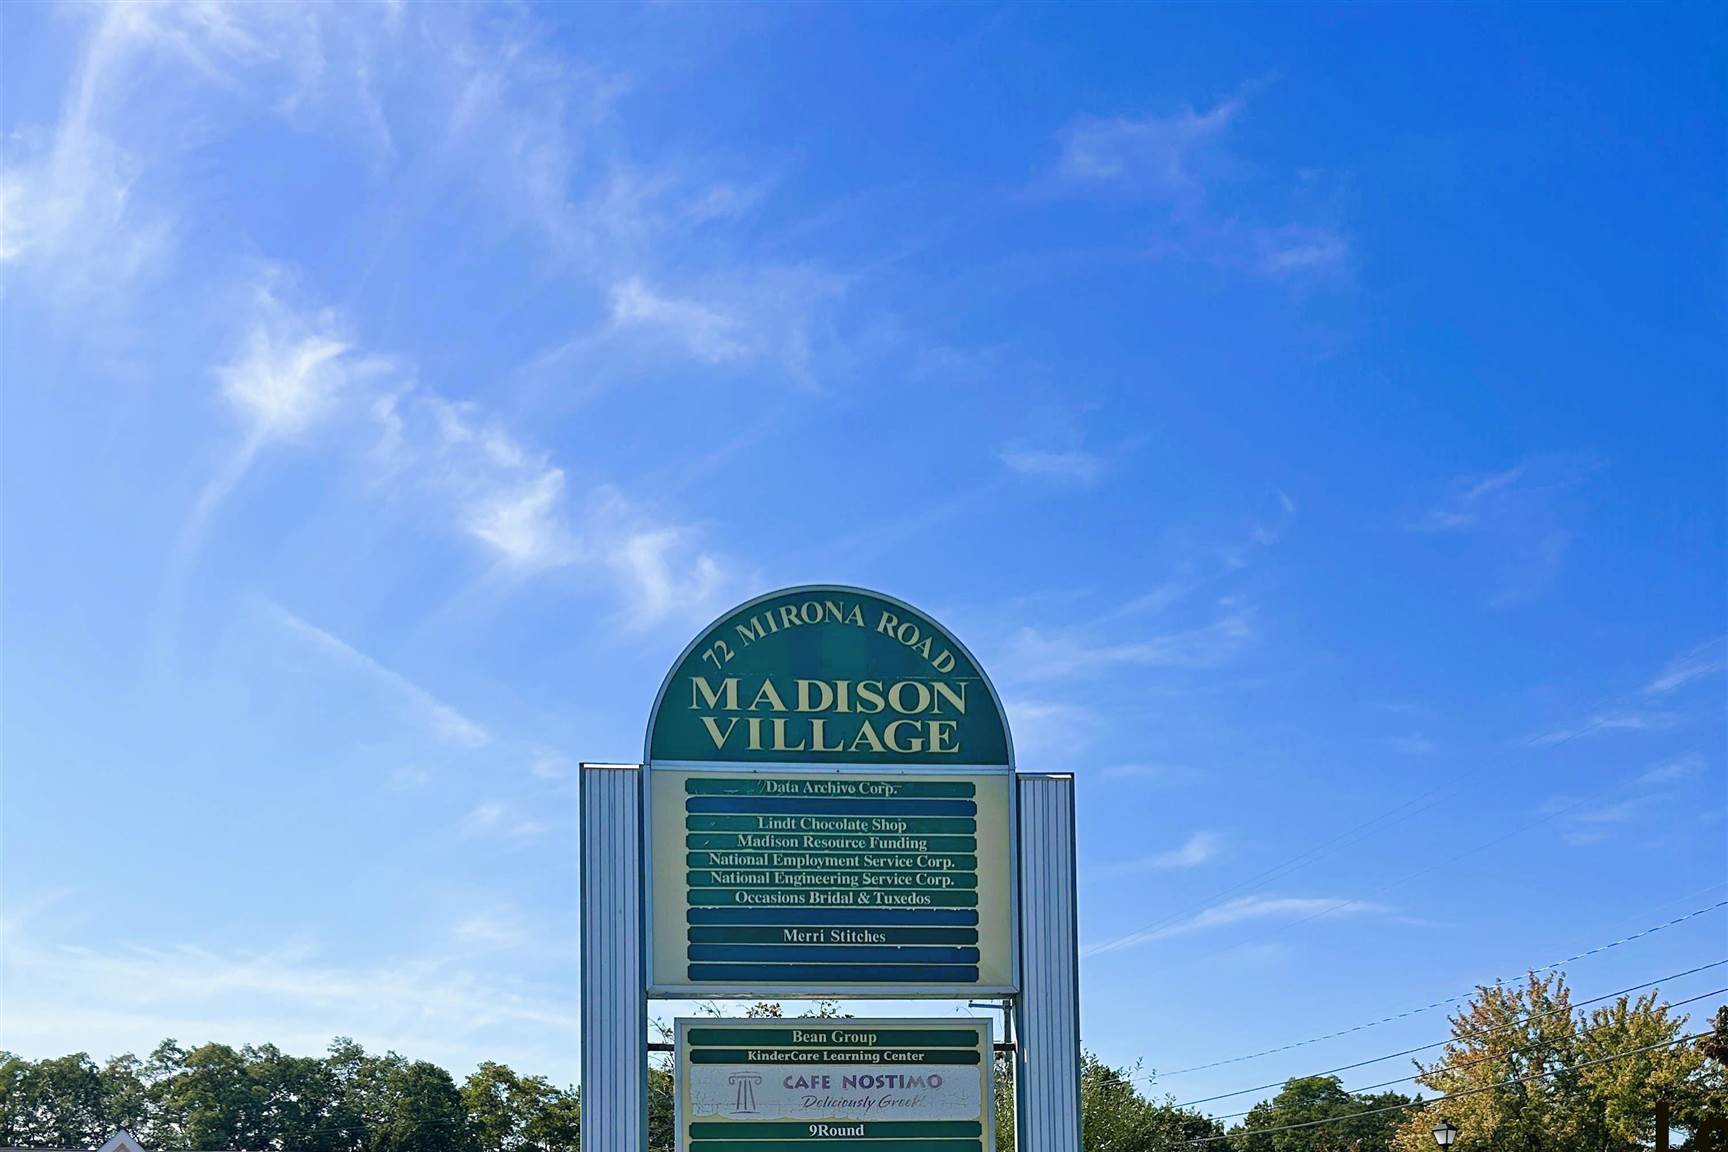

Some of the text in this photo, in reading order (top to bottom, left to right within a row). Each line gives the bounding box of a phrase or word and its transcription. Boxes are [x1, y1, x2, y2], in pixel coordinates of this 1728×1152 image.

[702, 601, 956, 674] 72 MIRONA ROAD
[688, 676, 970, 715] MADISON
[700, 716, 961, 754] VILLAGE
[766, 780, 799, 793] Data
[859, 782, 898, 797] Corp.
[757, 816, 907, 833] Lindt Chocolate Shop
[737, 834, 928, 851] Madison Resource Funding
[708, 852, 956, 870] National Employment Service Corp.
[711, 871, 955, 888] National Engineering Service Corp.
[735, 890, 931, 905] Occasions Bridal & Tuxedos
[783, 929, 887, 943] Merri Stitches
[793, 1030, 878, 1046] Bean Group
[747, 1051, 925, 1063] KinderCare Learning Center
[783, 1073, 943, 1090] CAFE NOSTIMO
[799, 1094, 878, 1113] Deliciously
[808, 1123, 866, 1138] 9Round
